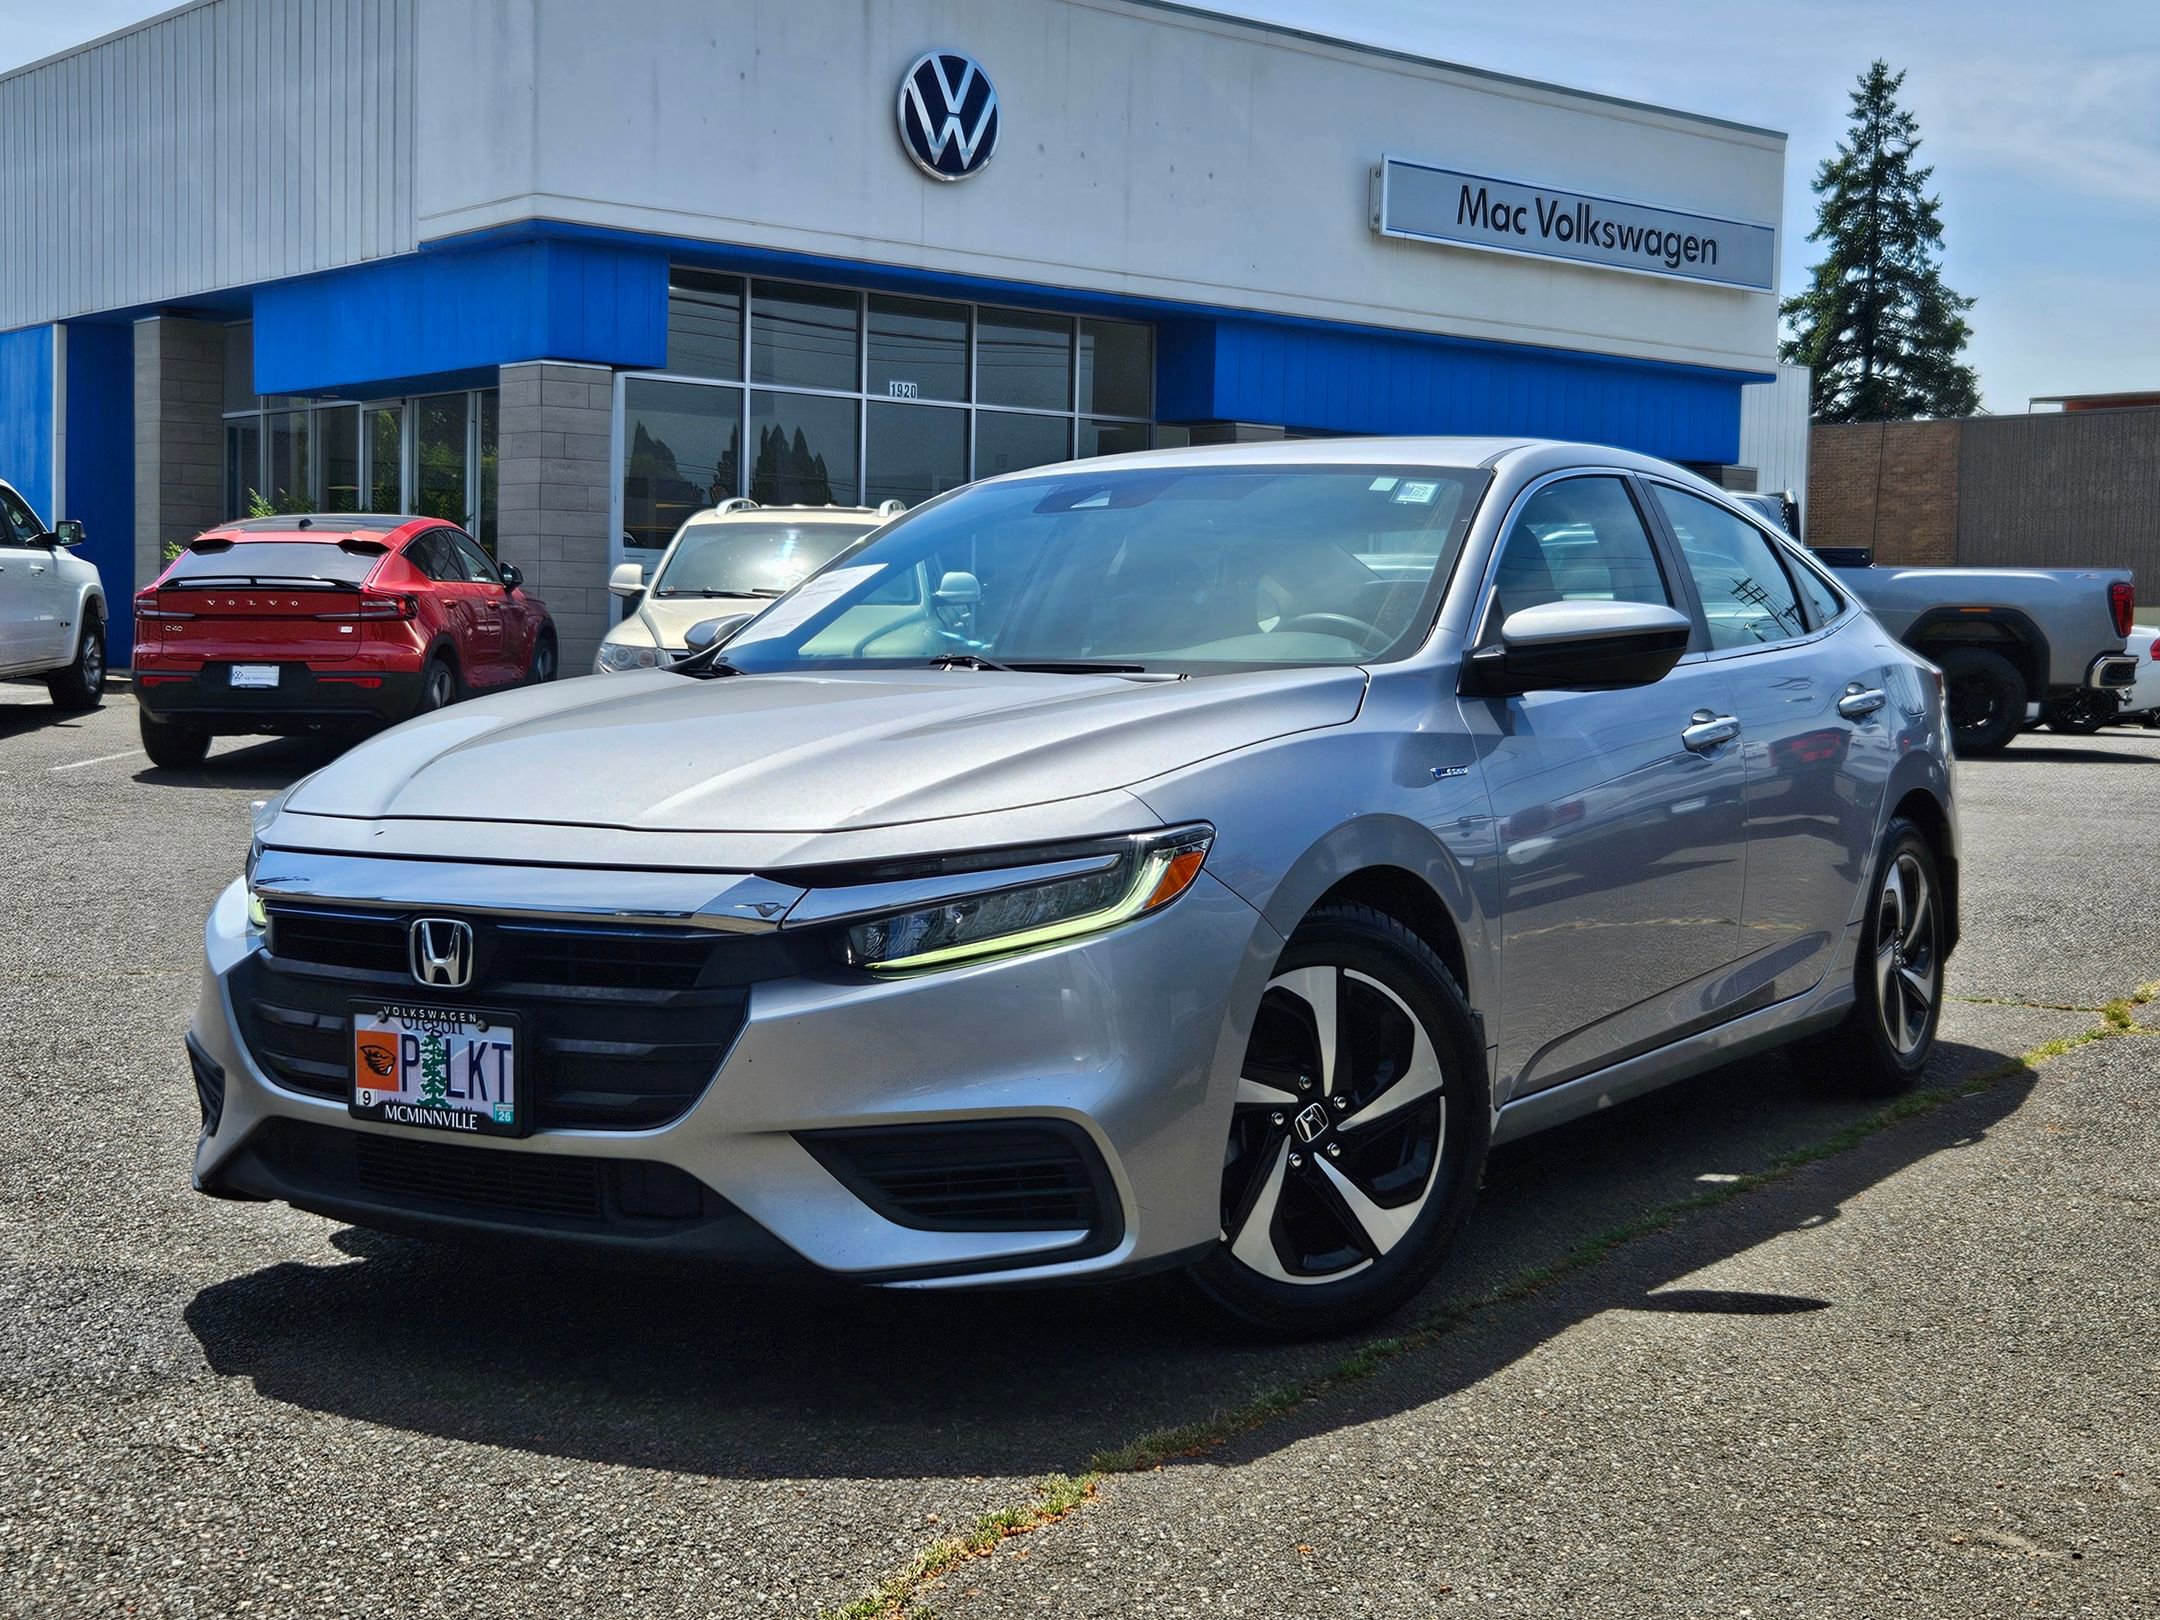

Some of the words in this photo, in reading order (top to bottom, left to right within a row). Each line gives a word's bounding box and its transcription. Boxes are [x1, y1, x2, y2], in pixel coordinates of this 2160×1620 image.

[1457, 184, 1527, 236] Mac
[1535, 197, 1718, 270] Volkswagen
[891, 383, 917, 399] 1920
[383, 1006, 477, 1022] VOLKSWAGEN
[401, 1018, 465, 1038] Oregon
[362, 1091, 371, 1105] 9
[384, 1104, 478, 1130] MCMINNVILLE
[498, 1111, 511, 1122] 26
